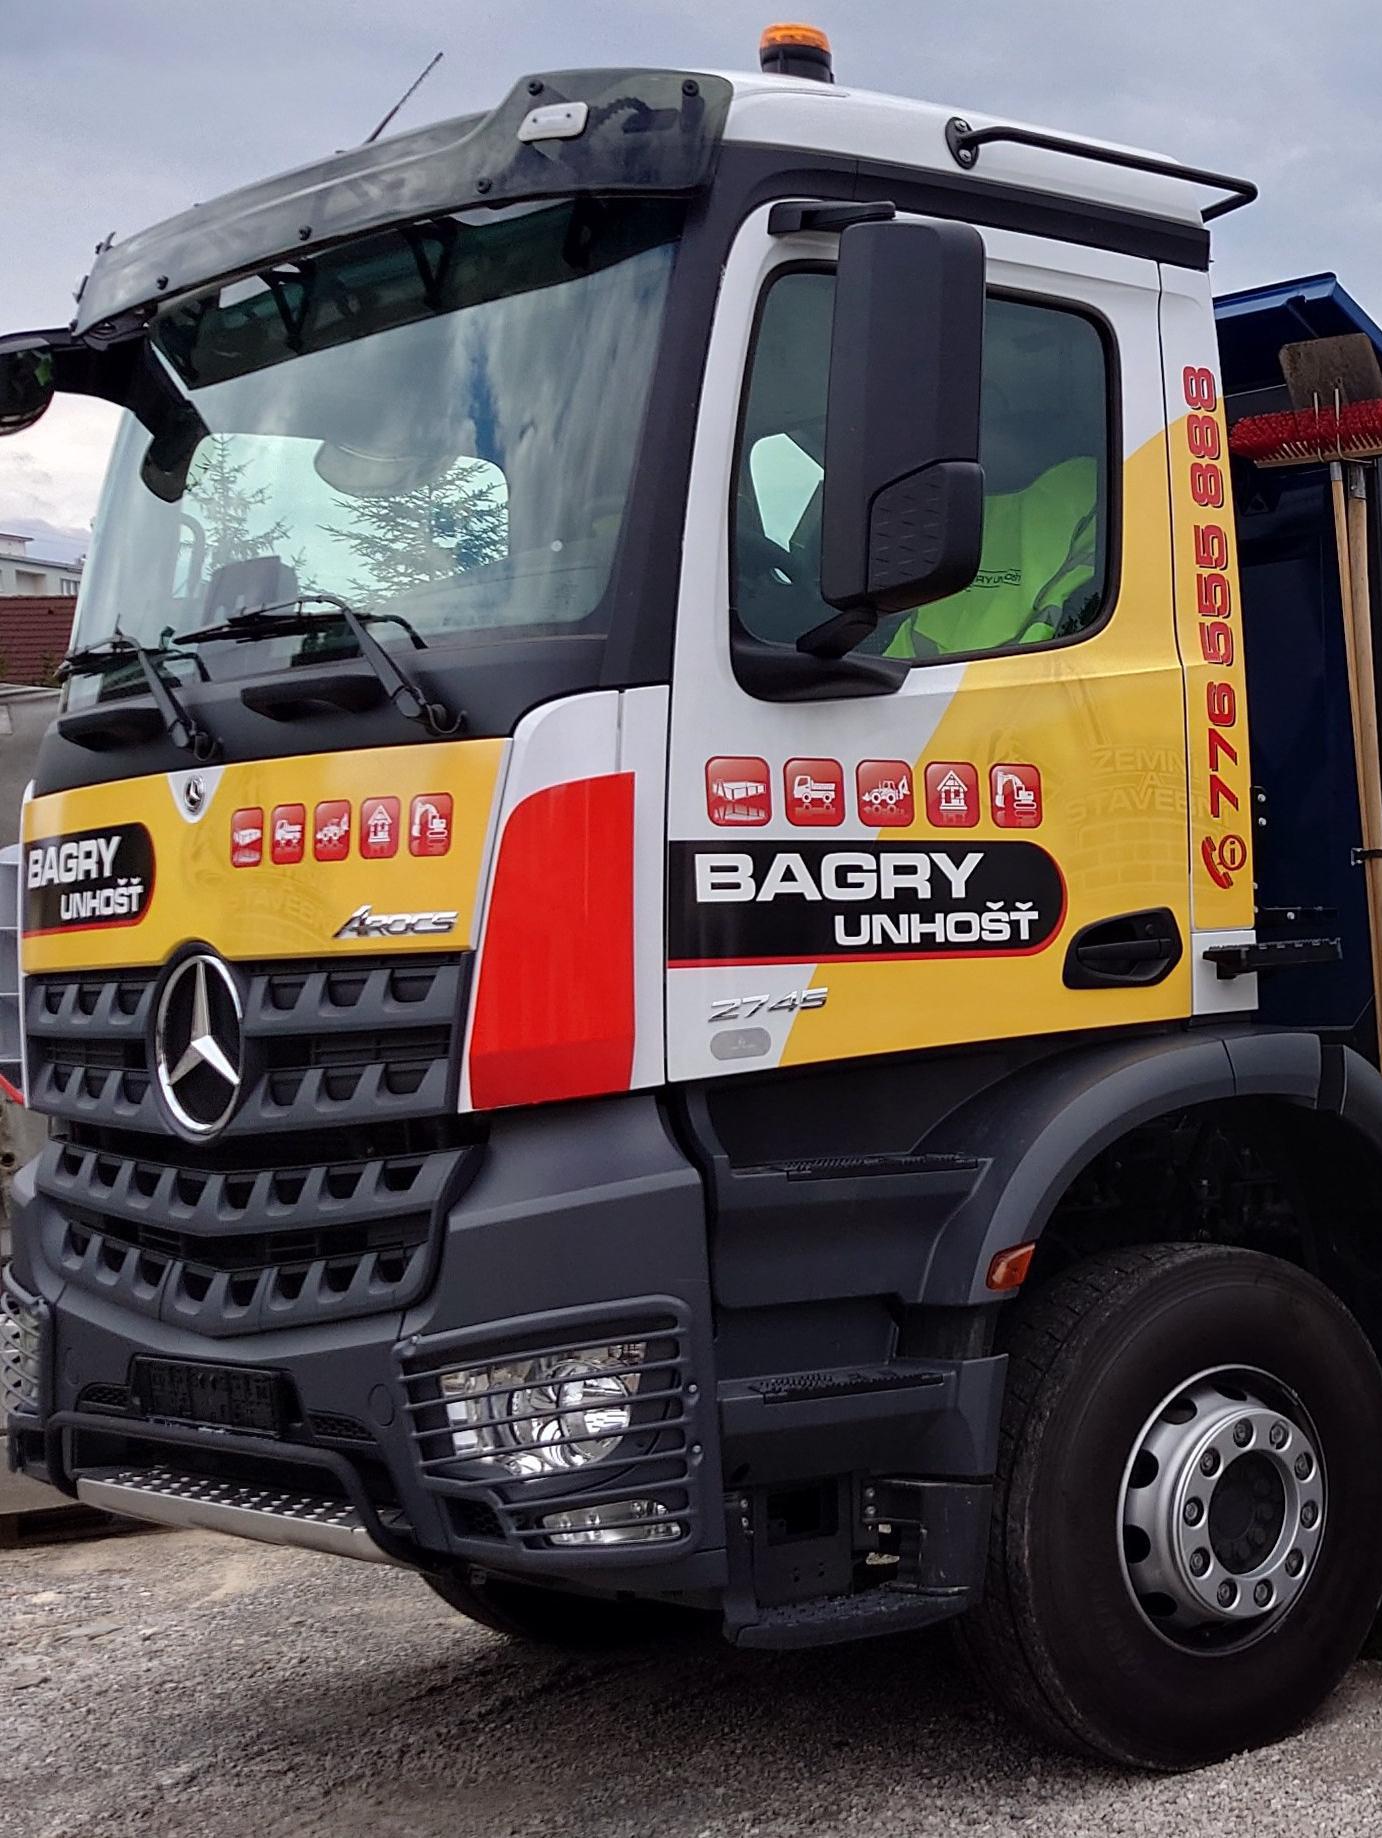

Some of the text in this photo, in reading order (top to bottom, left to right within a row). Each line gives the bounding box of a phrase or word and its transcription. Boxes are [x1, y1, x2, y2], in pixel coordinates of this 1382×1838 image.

[1182, 366, 1240, 819] 776 555 888
[28, 835, 122, 889] BAGRY
[695, 852, 985, 903] BAGRY
[60, 876, 145, 920] UNHOŠŤ
[835, 900, 1039, 946] UNHOŠŤ
[708, 986, 828, 1022] 2745
